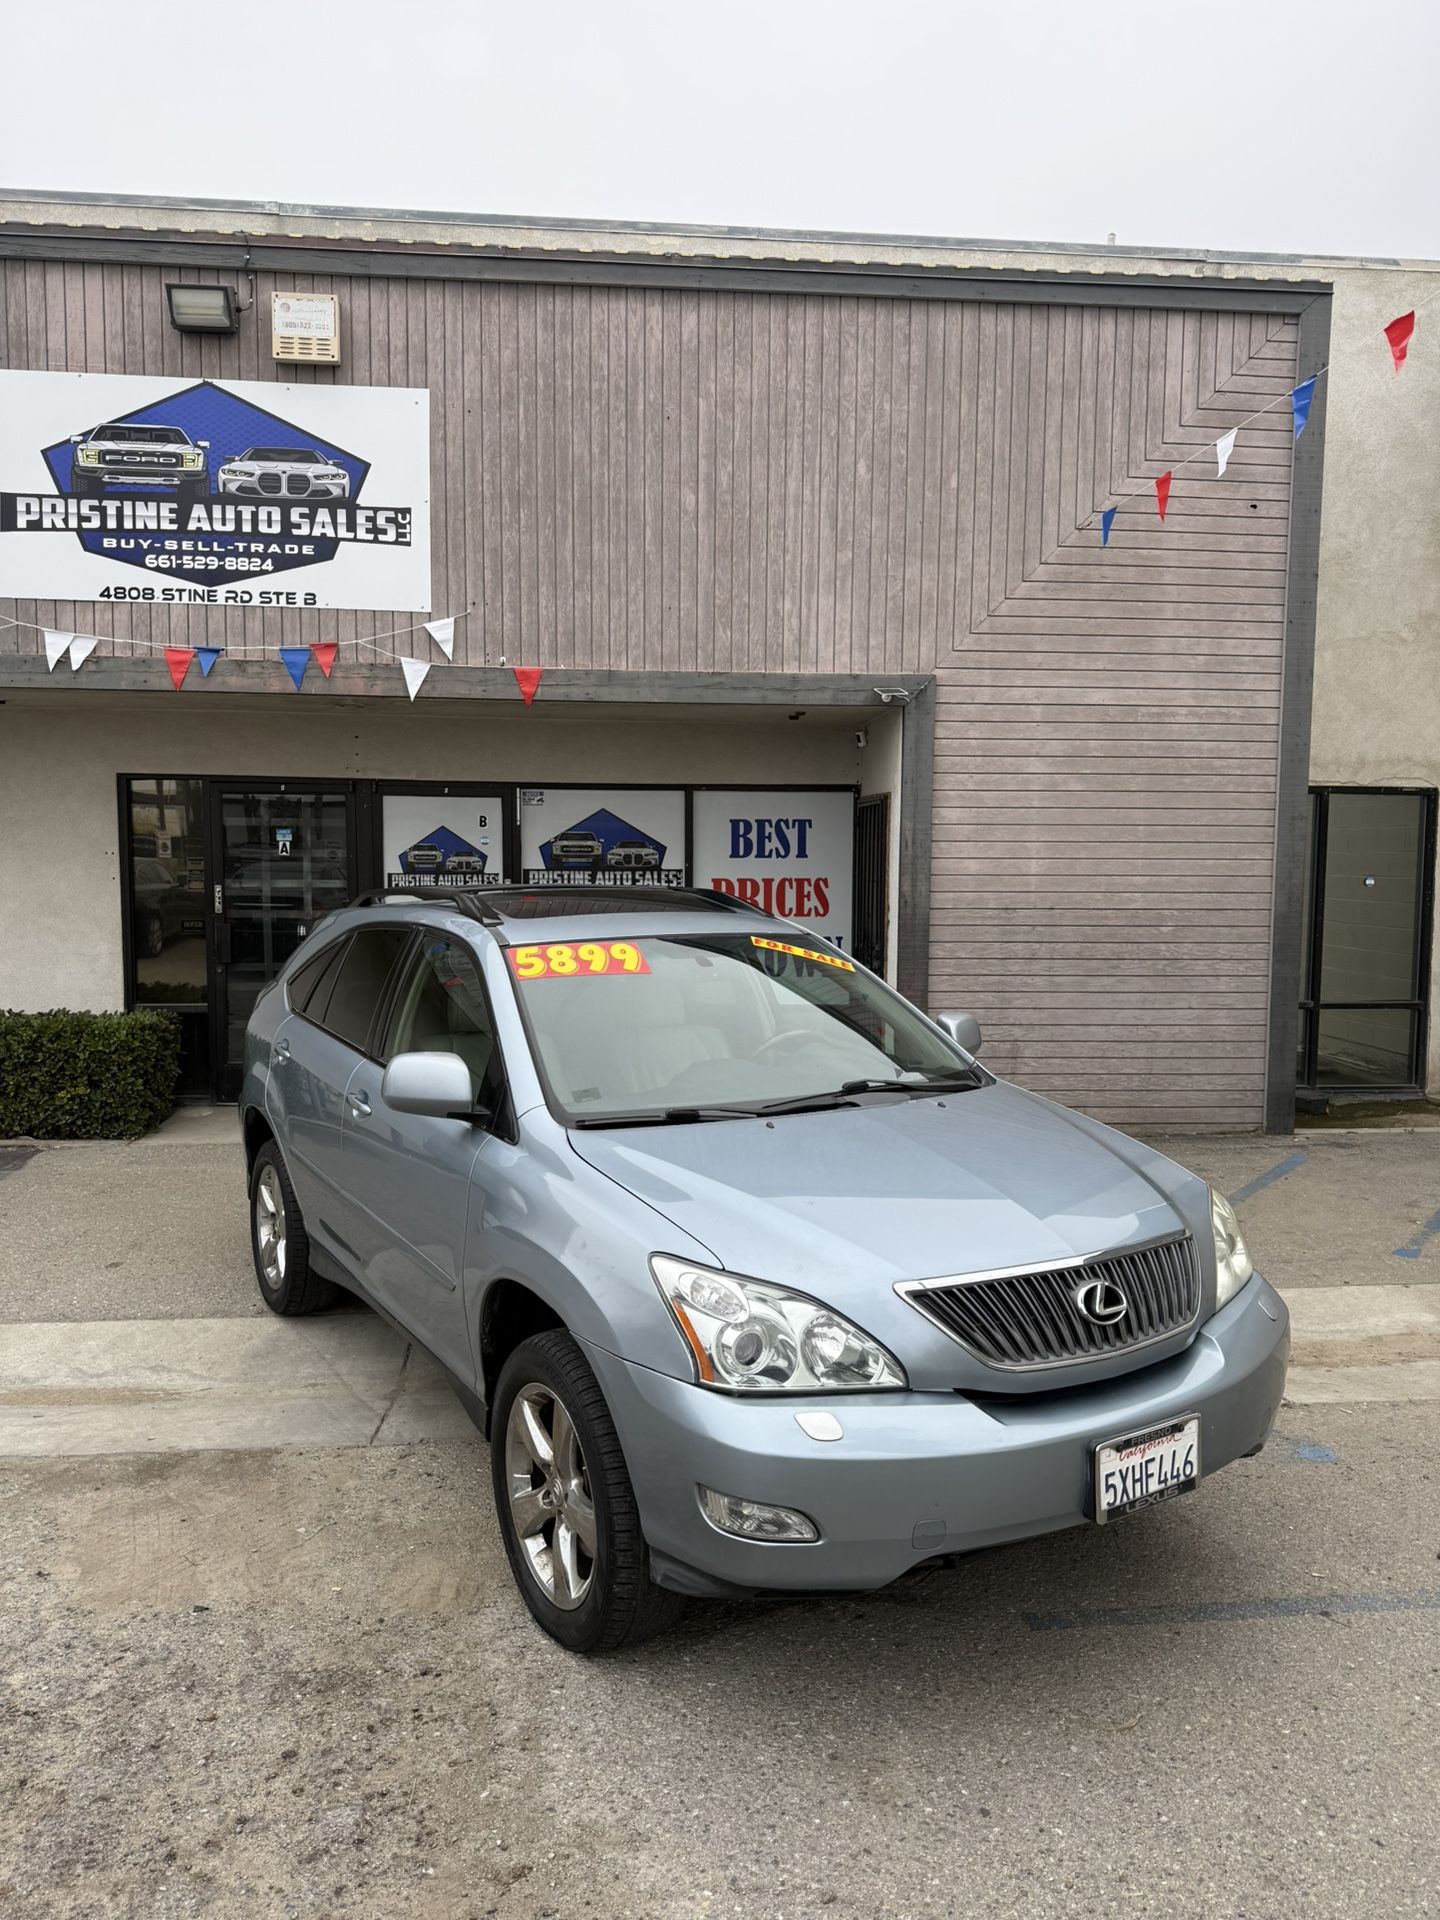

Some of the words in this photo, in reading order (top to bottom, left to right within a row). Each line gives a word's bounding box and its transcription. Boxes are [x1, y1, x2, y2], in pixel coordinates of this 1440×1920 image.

[105, 454, 177, 464] FORD
[16, 497, 178, 530] PRISTINE
[187, 503, 281, 534] AUTO
[290, 506, 396, 542] SALES
[397, 512, 411, 542] LLC
[103, 538, 315, 555] BUY-SELL-TRADE
[145, 555, 274, 571] 661-529-8824
[99, 586, 156, 600] 4808
[162, 588, 218, 602] STINE
[224, 590, 253, 603] RD
[259, 591, 297, 605] STE
[303, 593, 317, 605] B
[479, 815, 488, 828] B
[729, 818, 813, 859] BEST
[280, 842, 289, 855] A
[391, 874, 436, 887] PRISTINE
[438, 874, 464, 886] AUTO
[465, 875, 496, 885] SALES
[529, 871, 592, 885] PRISTINE
[595, 871, 632, 886] AUTO
[635, 872, 677, 887] SALES
[515, 943, 642, 978] 5899
[754, 938, 793, 953] FOR
[803, 949, 850, 969] SALE
[1131, 1426, 1172, 1446] FRESNO
[1118, 1434, 1182, 1462] California
[1104, 1443, 1194, 1507] 5XHF446
[1126, 1486, 1179, 1513] LEXUS
